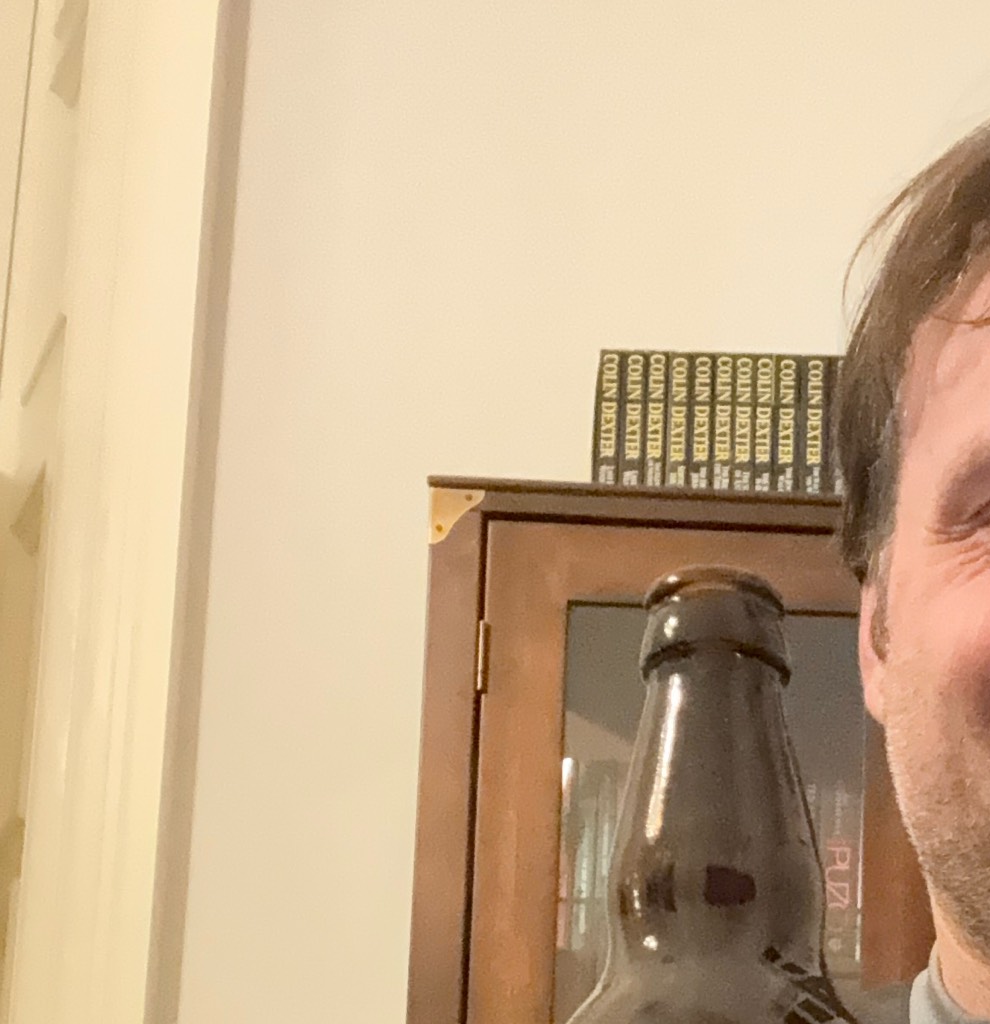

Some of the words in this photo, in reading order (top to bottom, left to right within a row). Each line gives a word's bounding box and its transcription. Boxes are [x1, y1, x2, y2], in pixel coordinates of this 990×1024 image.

[603, 354, 619, 398] COLIN
[627, 355, 644, 399] COLIN
[649, 354, 666, 399] COLIN
[672, 357, 688, 402] COLIN
[695, 356, 711, 402] COLIN
[716, 356, 733, 402] COLIN
[736, 357, 752, 402] COLIN
[757, 358, 773, 403] COLIN
[780, 359, 796, 404] COLIN
[807, 360, 823, 405] COLIN
[600, 402, 618, 458] DEXTER
[625, 403, 641, 459] DEXTER
[647, 403, 664, 459] DEXTER
[670, 406, 687, 461] DEXTER
[693, 406, 710, 462] DEXTER
[714, 404, 731, 461] DEXTER
[735, 406, 752, 463] DEXTER
[755, 407, 772, 463] DEXTER
[778, 408, 795, 464] DEXTER
[806, 408, 823, 465] DEXTER
